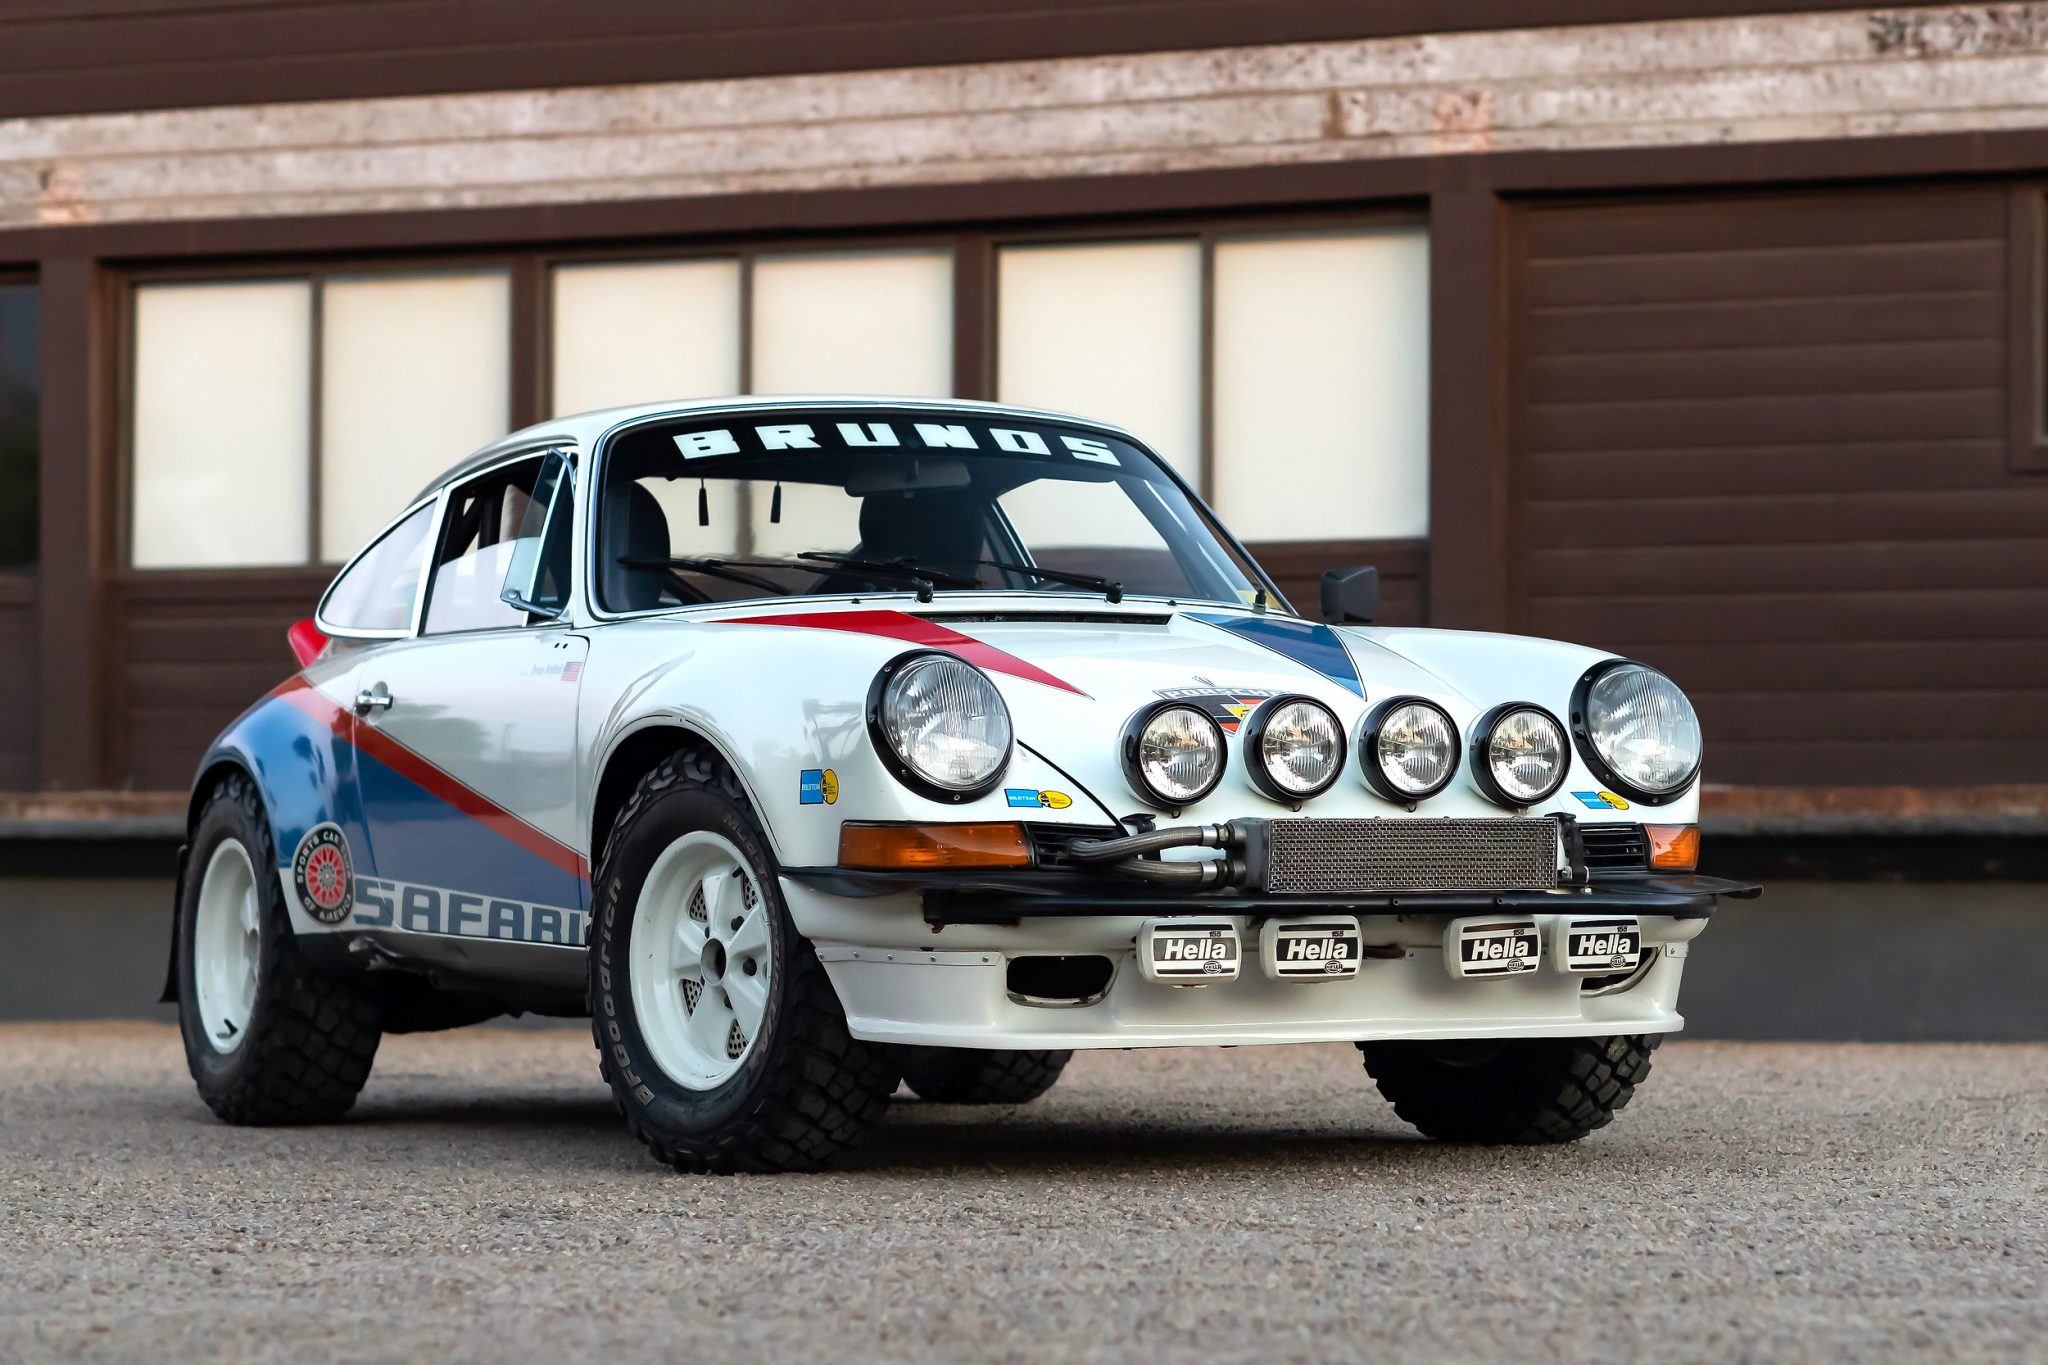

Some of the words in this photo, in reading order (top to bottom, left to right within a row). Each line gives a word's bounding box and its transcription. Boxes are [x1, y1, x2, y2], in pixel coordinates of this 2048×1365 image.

[672, 423, 1121, 467] BRUNOS
[297, 834, 320, 884] SPORTS
[323, 831, 339, 844] CAR
[319, 893, 352, 920] AMERICA
[352, 878, 581, 945] SAFARI
[1208, 930, 1222, 938] 155
[1331, 930, 1344, 938] 155
[1577, 933, 1631, 956] Hella
[1164, 938, 1227, 960] Hella
[1286, 938, 1349, 960] Hella
[1471, 937, 1529, 960] Hella
[601, 876, 656, 1106] BFGoodrich
